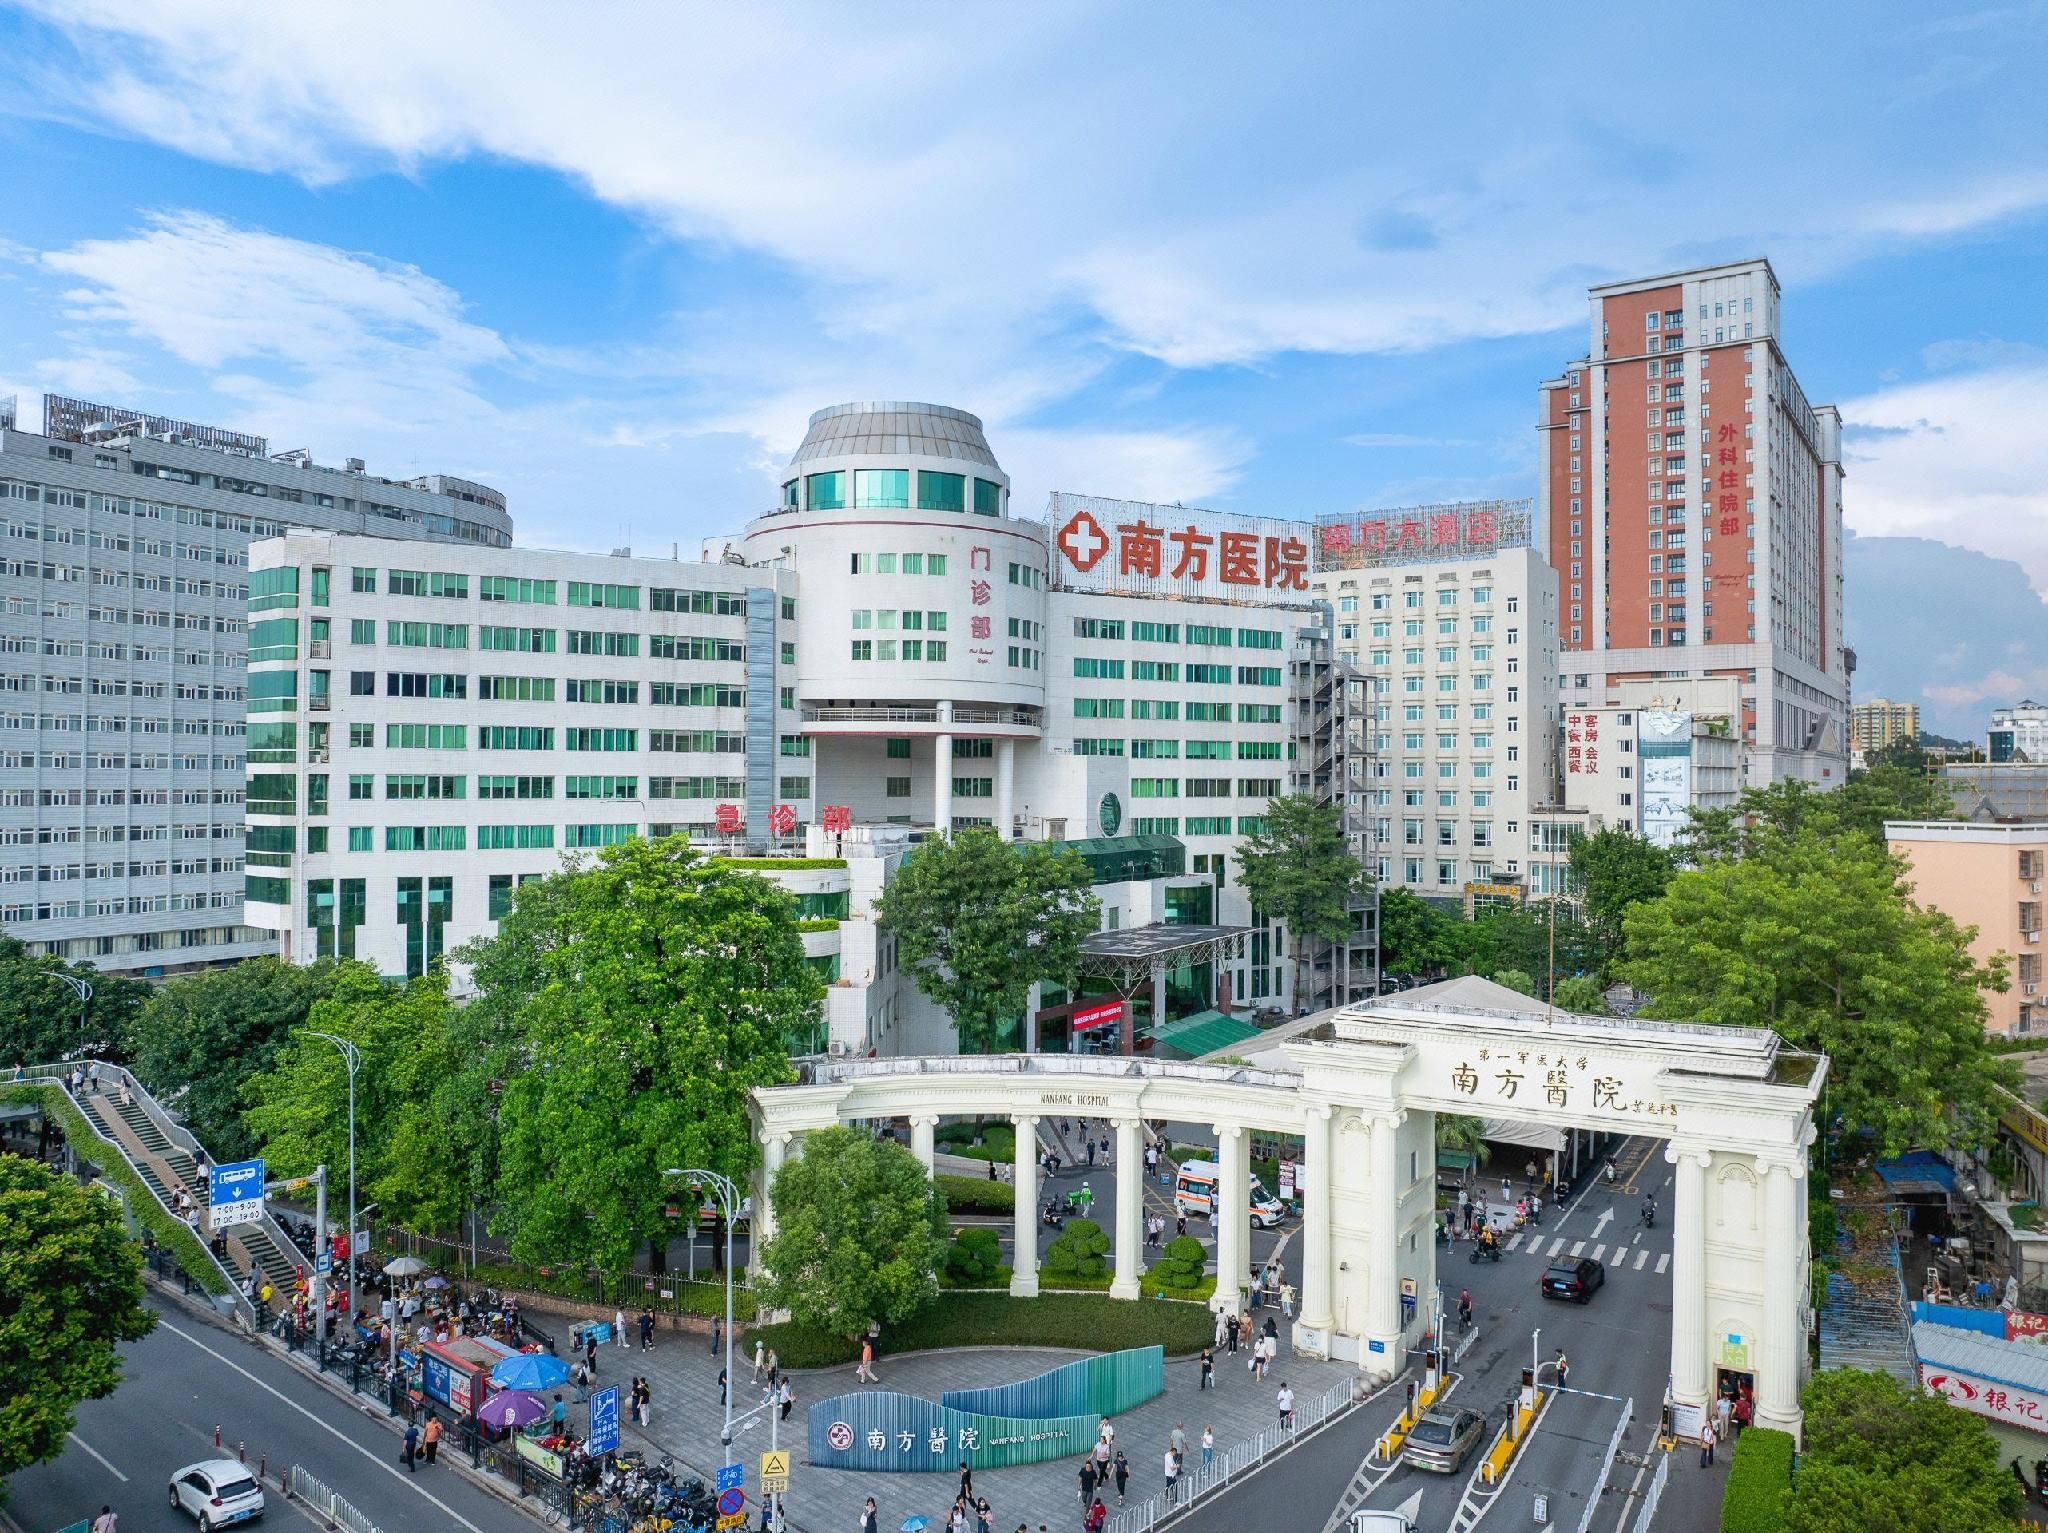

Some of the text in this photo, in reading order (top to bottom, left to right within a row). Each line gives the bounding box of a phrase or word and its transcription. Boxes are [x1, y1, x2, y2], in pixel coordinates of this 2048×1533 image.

[1718, 423, 1739, 536] 外科住院部
[1117, 519, 1309, 590] 南方医院
[970, 545, 991, 640] 门诊部
[715, 803, 849, 834] 急诊部
[1077, 1095, 1109, 1107] HOSPITAL
[1452, 1062, 1627, 1111] 南方醫院
[1983, 1388, 2043, 1420] 银记
[867, 1426, 981, 1454] 南方醫院
[989, 1430, 1069, 1447] NANFANG HOSPITAL
